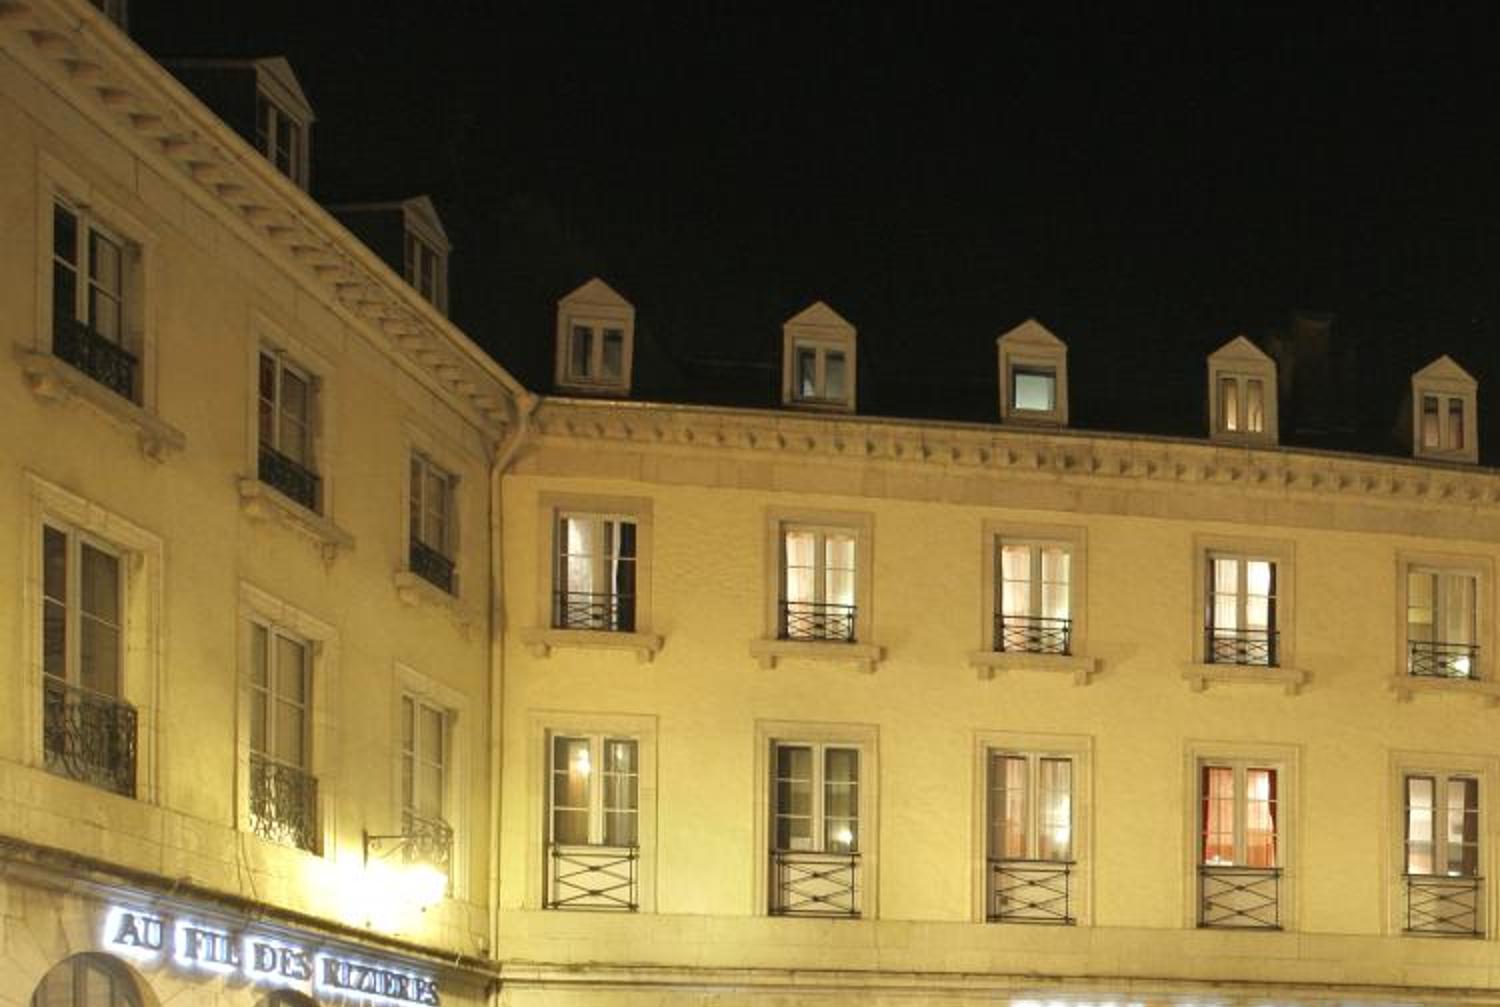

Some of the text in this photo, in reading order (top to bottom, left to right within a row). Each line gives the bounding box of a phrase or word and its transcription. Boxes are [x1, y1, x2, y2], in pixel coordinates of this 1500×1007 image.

[112, 912, 163, 950] AU
[183, 926, 241, 967] FIL
[253, 942, 312, 981] DES
